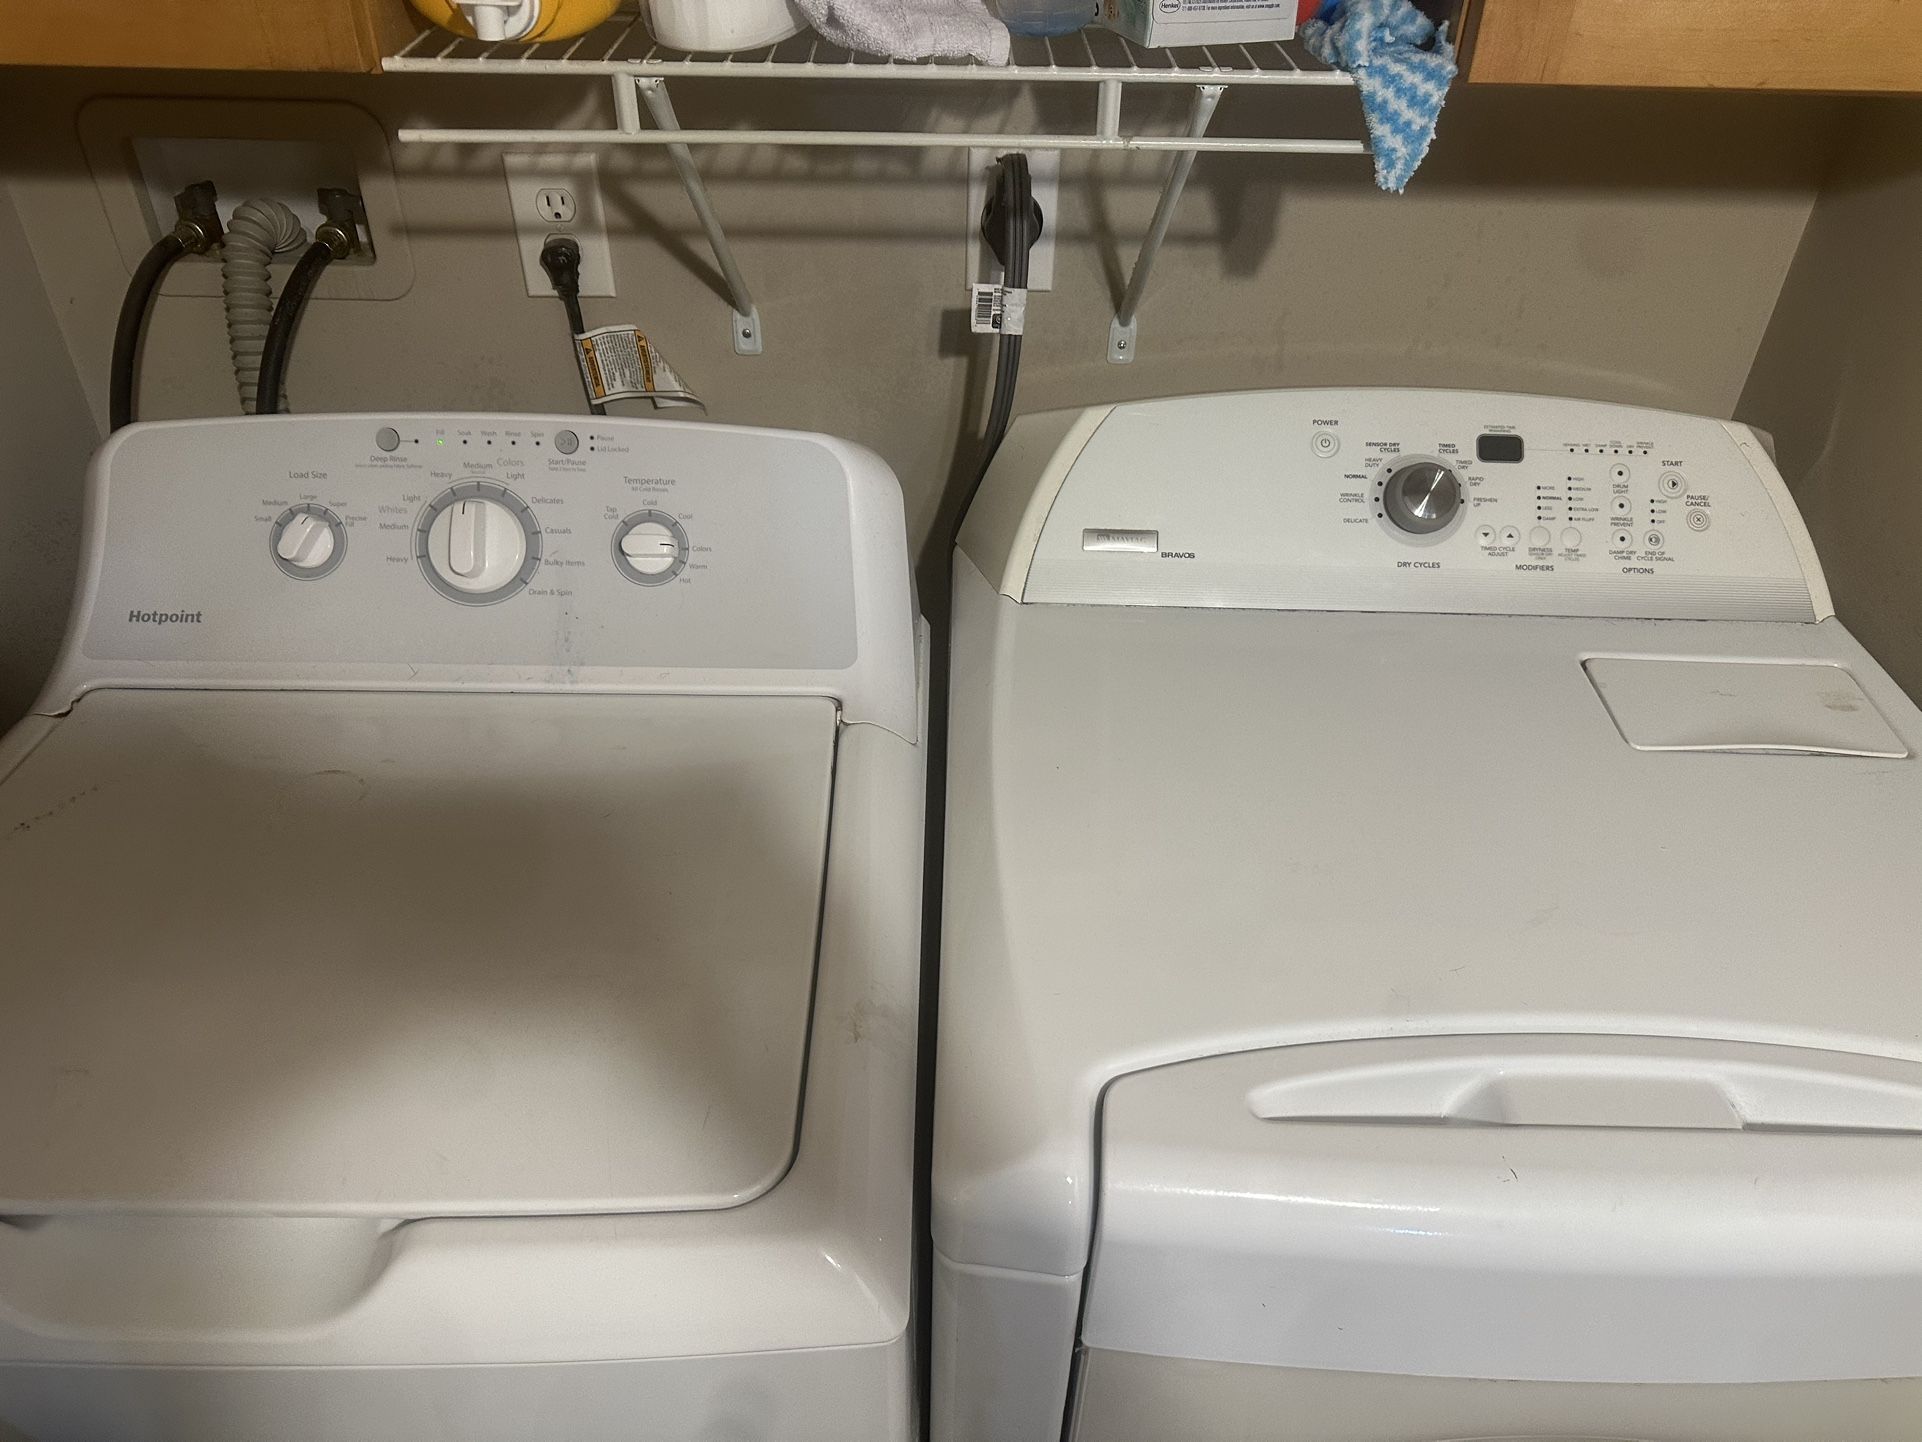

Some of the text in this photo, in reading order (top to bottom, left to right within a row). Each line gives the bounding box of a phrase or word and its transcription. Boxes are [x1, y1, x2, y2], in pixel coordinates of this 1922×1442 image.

[370, 455, 388, 463] Deep
[496, 457, 525, 467] Colors
[548, 458, 587, 466] Start/Pause
[289, 470, 328, 479] Load Size
[430, 471, 453, 480] Heavy
[506, 472, 526, 480] Light
[623, 476, 676, 487] Temperature
[402, 494, 421, 503] Light
[531, 496, 565, 505] Delicates
[642, 498, 658, 506] Cold
[378, 505, 408, 514] Whites
[605, 506, 617, 514] Tap
[603, 512, 619, 520] Cold
[678, 512, 693, 520] Cool
[379, 522, 409, 530] Medium
[545, 527, 572, 535] Casuals
[692, 545, 712, 553] Colors
[386, 555, 409, 564] Heavy
[544, 559, 585, 568] Bulky Items
[528, 588, 549, 596] Drain
[556, 588, 573, 598] Spin
[128, 609, 203, 625] Hotpoint
